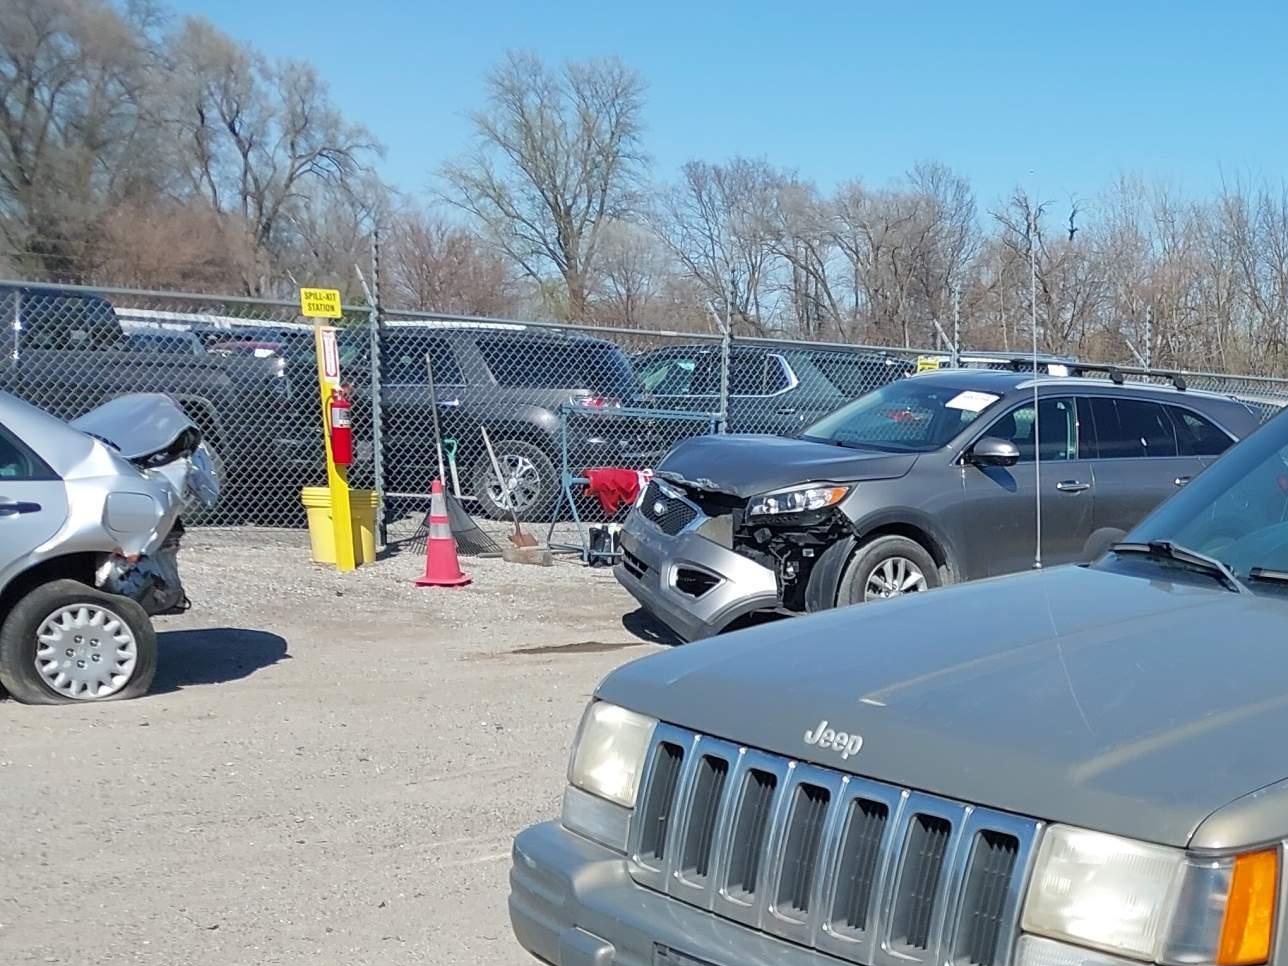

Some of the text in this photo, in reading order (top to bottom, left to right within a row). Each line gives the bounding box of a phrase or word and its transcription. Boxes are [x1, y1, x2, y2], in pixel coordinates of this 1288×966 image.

[304, 291, 336, 301] SPILL-KIT
[307, 302, 335, 312] STATION
[803, 719, 863, 760] Jeep
